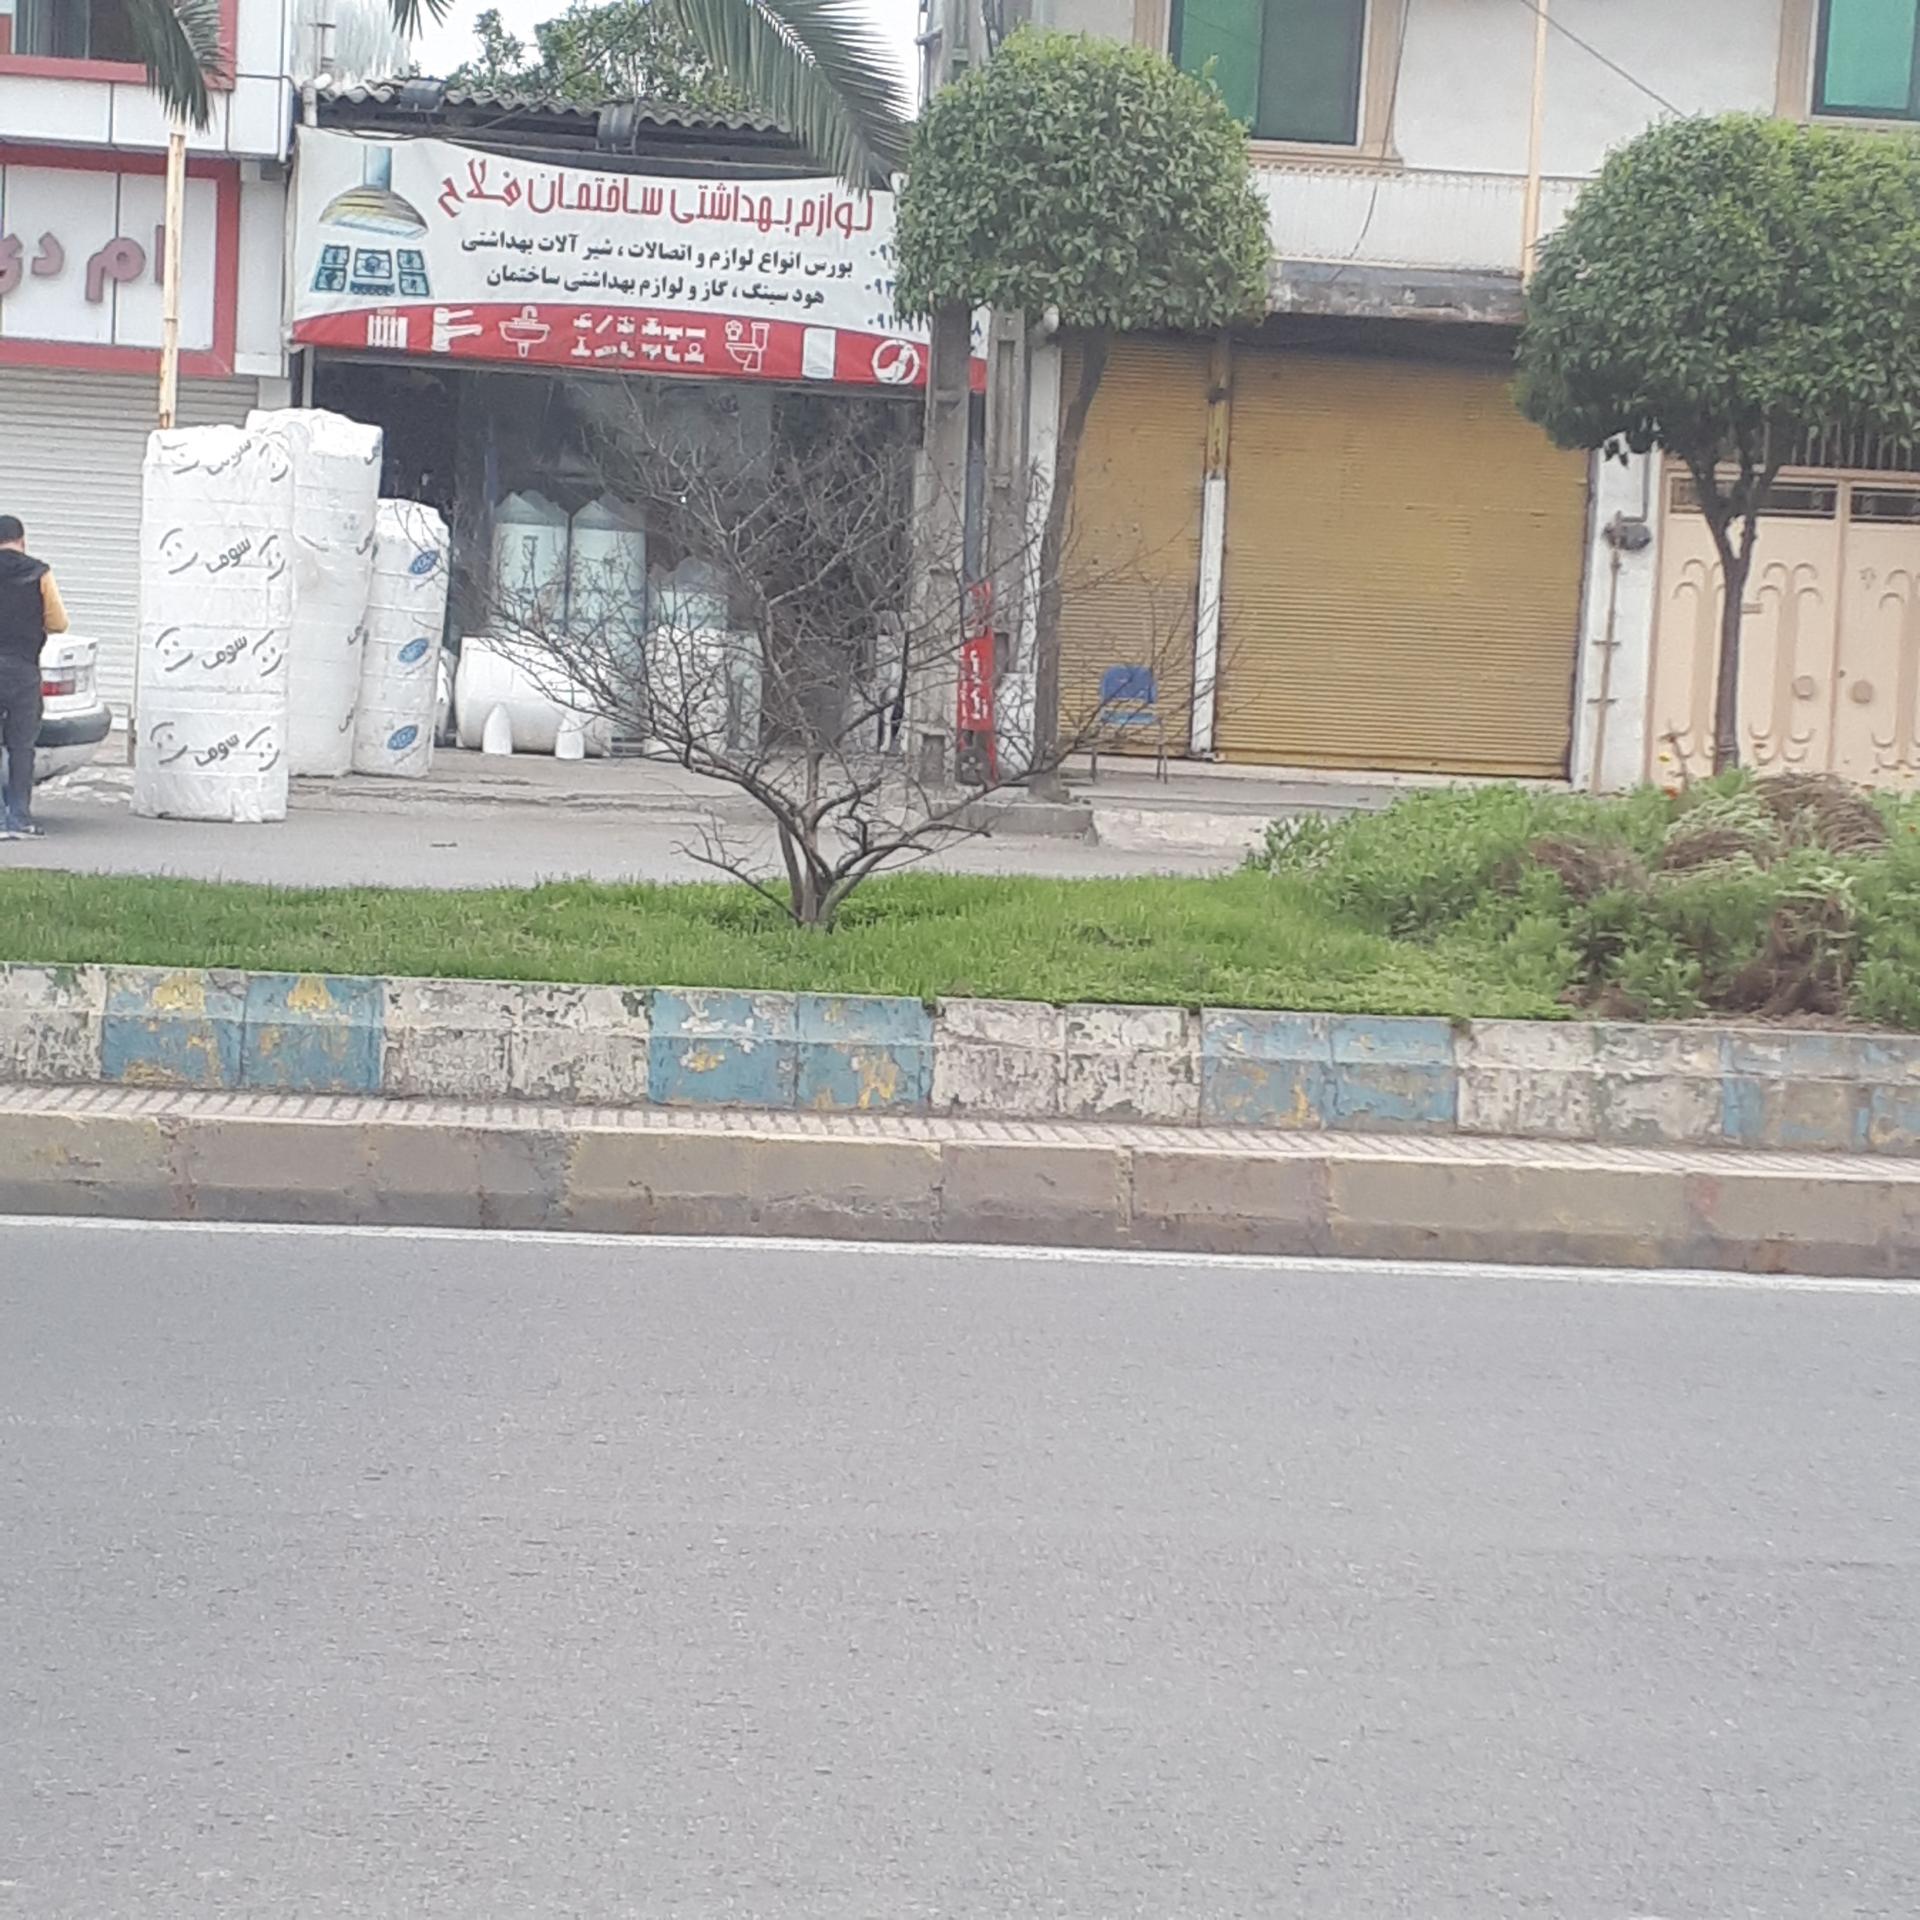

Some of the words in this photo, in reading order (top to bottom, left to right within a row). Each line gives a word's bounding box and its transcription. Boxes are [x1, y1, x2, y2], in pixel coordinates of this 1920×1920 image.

[437, 157, 523, 219] فلاح
[528, 172, 663, 216] ساختمان
[670, 182, 793, 233] بهداشتی
[795, 191, 873, 239] لوازم
[461, 230, 534, 255] بهداشتی
[538, 233, 579, 253] آلات
[581, 238, 614, 260] شیر
[695, 252, 705, 268] و
[709, 247, 754, 270] لوازم
[758, 250, 801, 275] انواع
[804, 261, 853, 279] بورس
[486, 263, 561, 286] ساختمان
[564, 271, 636, 296] بهداشتی
[639, 276, 684, 298] لوازم
[687, 284, 697, 300] و
[701, 278, 728, 301] گاز
[792, 287, 825, 309] هود
